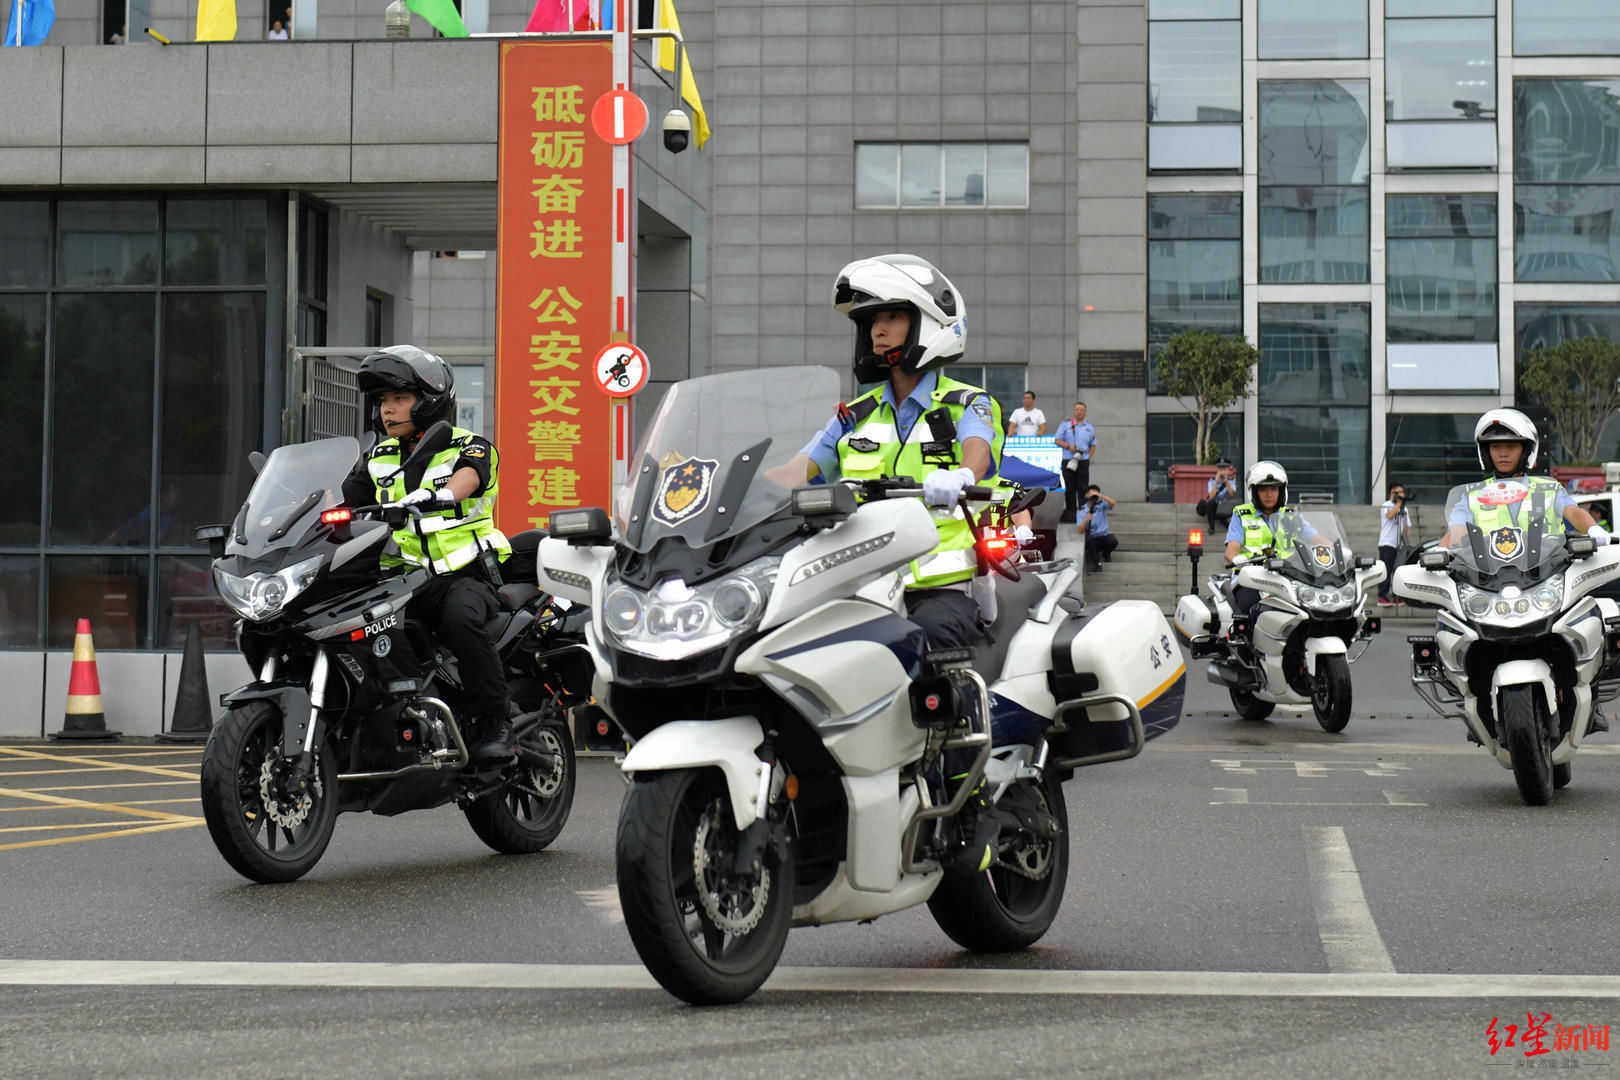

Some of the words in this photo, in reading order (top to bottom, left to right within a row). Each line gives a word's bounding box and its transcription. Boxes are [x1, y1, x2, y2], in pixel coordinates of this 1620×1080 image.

[529, 85, 585, 259] 砥砺奋进
[527, 286, 583, 528] 公安交警建
[364, 614, 397, 638] POLICE
[1150, 634, 1172, 670] 公安
